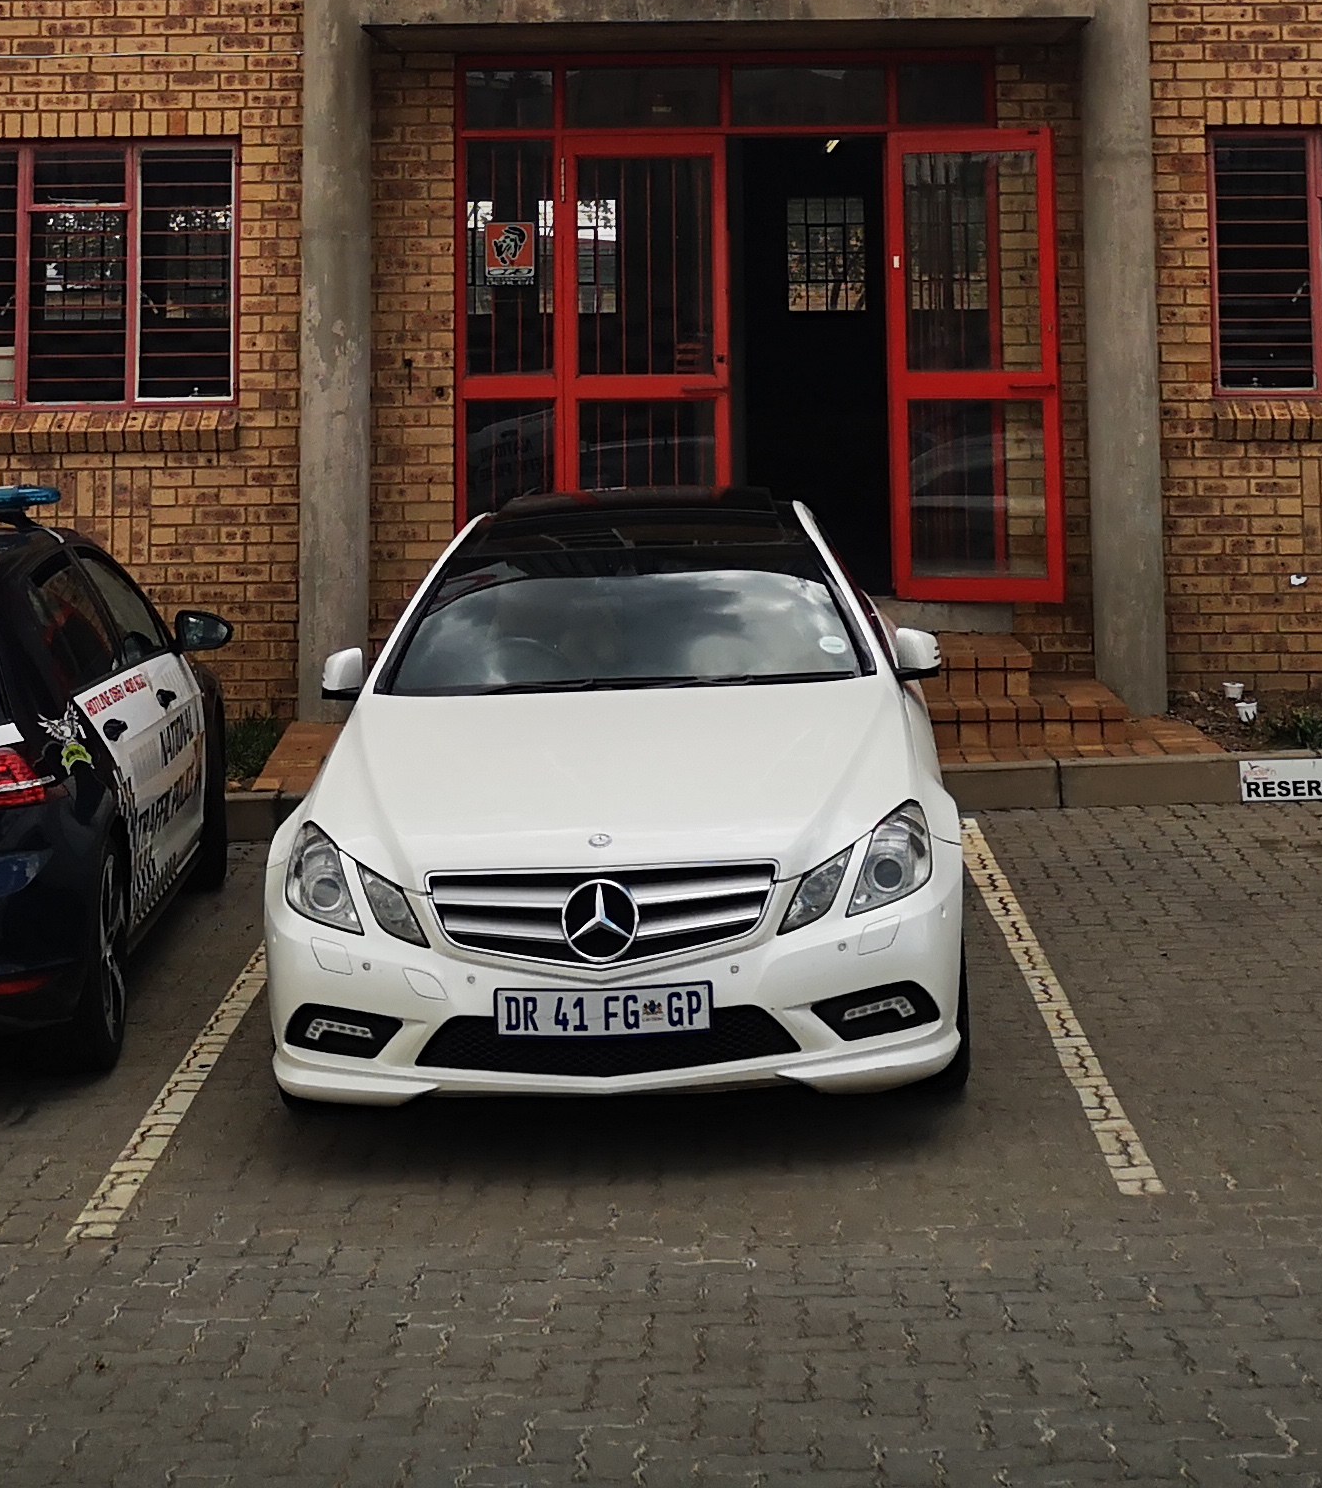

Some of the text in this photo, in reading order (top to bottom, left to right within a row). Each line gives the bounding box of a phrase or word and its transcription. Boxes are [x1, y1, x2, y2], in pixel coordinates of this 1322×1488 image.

[505, 990, 702, 1032] DR 41 FG GP
